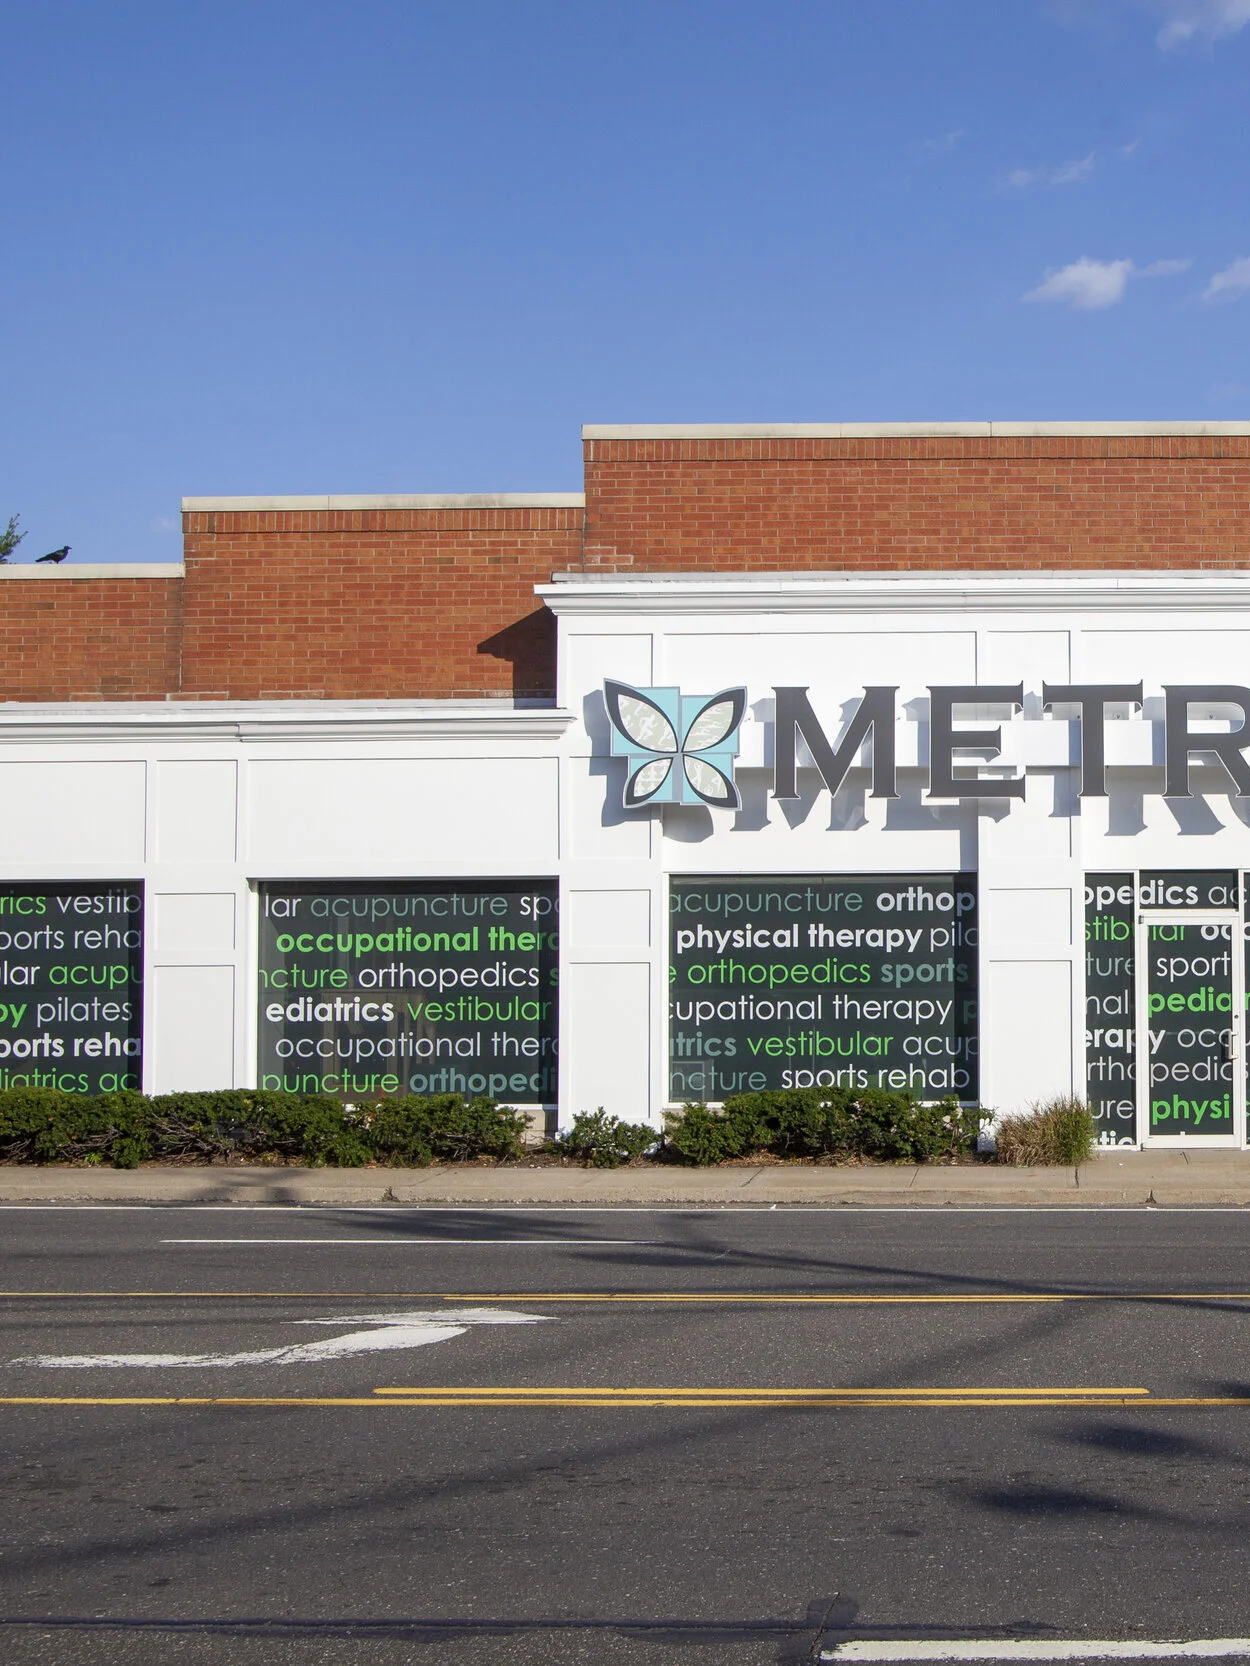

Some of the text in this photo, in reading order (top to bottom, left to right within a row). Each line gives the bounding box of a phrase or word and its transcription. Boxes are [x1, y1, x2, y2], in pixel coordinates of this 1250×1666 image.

[56, 888, 142, 914] vestib
[265, 893, 302, 917] lar
[310, 893, 508, 922] acupuncture
[669, 886, 975, 918] acupuncture orthop
[276, 927, 478, 957] occupational
[677, 924, 799, 954] physical
[808, 923, 923, 953] therapy
[0, 960, 40, 985] lar
[358, 961, 540, 993] orthopedics
[687, 958, 871, 989] orthopedics
[881, 957, 969, 988] sports
[37, 997, 133, 1028] pilates
[266, 996, 552, 1022] ediatrics vestibular
[669, 994, 822, 1026] upational
[832, 994, 953, 1025] therapy
[275, 1031, 481, 1063] occupational
[669, 1031, 736, 1057] trics
[747, 1031, 894, 1056] vestibular
[0, 1067, 89, 1093] iatrics
[262, 1068, 399, 1094] puncture
[781, 1064, 868, 1089] sports
[878, 1063, 970, 1088] rehab
